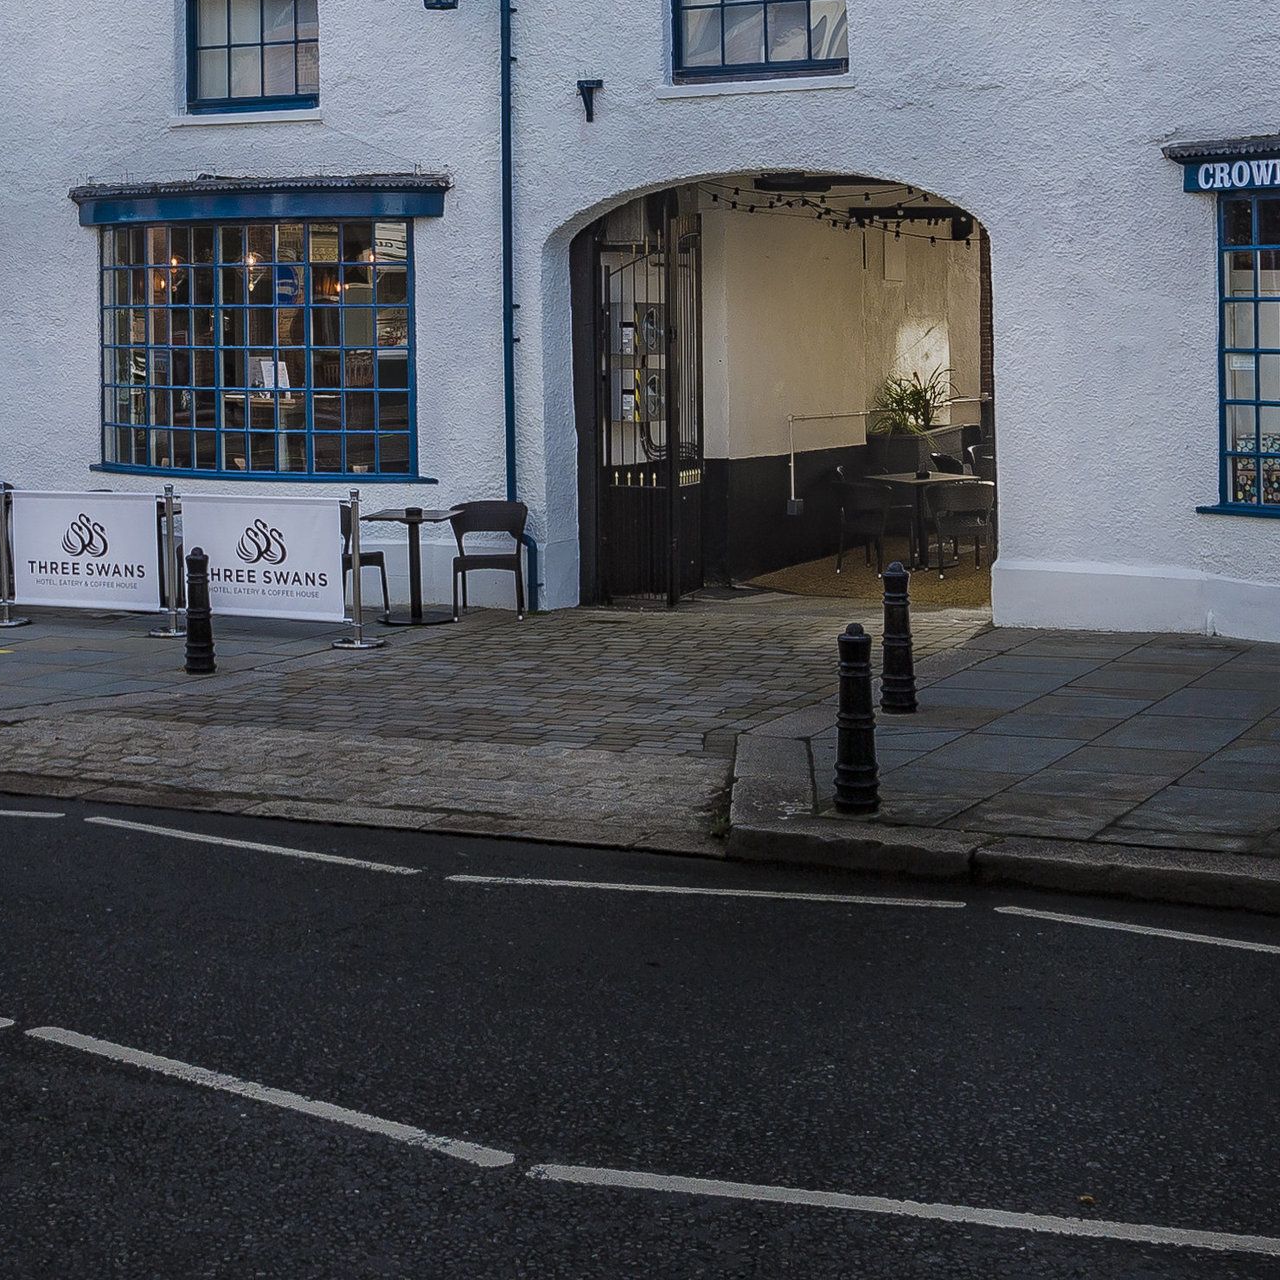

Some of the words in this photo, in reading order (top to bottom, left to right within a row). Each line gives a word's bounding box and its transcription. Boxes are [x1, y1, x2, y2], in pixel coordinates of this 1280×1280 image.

[28, 560, 80, 576] THREE
[86, 562, 146, 578] SWANS
[59, 579, 82, 587] EATERY
[210, 567, 257, 584] HREE
[263, 570, 328, 587] SWANS
[233, 587, 260, 596] EATERY
[267, 589, 294, 598] COFFEE
[295, 590, 320, 598] HOUSE
